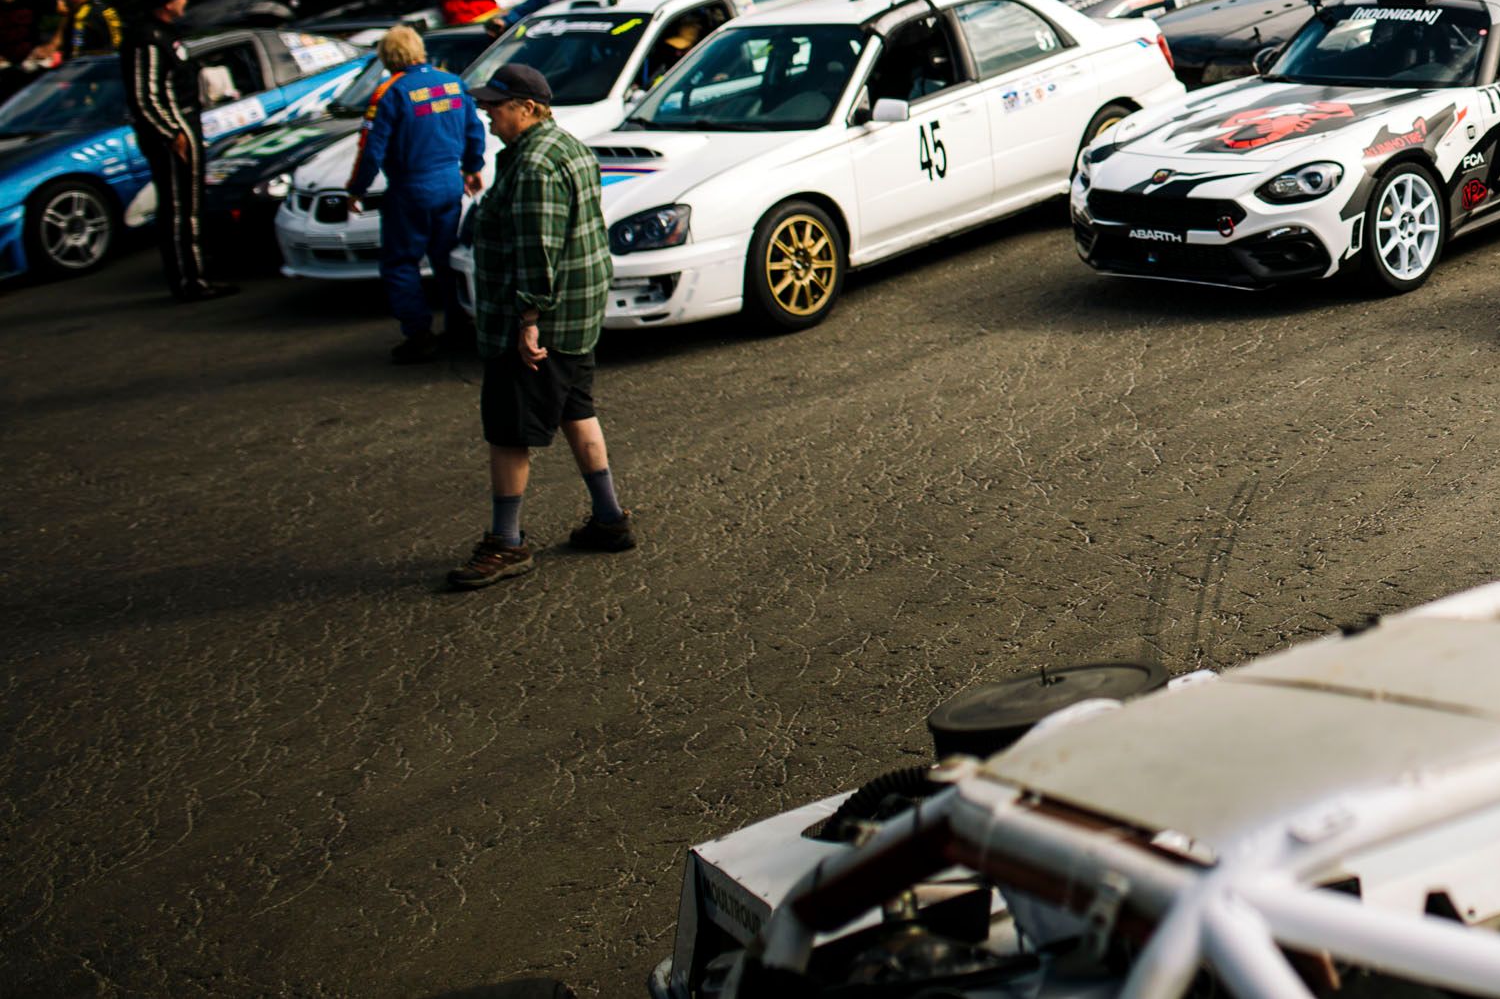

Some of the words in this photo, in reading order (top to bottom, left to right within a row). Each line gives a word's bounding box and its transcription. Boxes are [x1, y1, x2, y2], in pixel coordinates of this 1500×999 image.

[919, 120, 947, 181] 45
[1463, 152, 1485, 169] FCA
[1128, 229, 1182, 242] ABARTH
